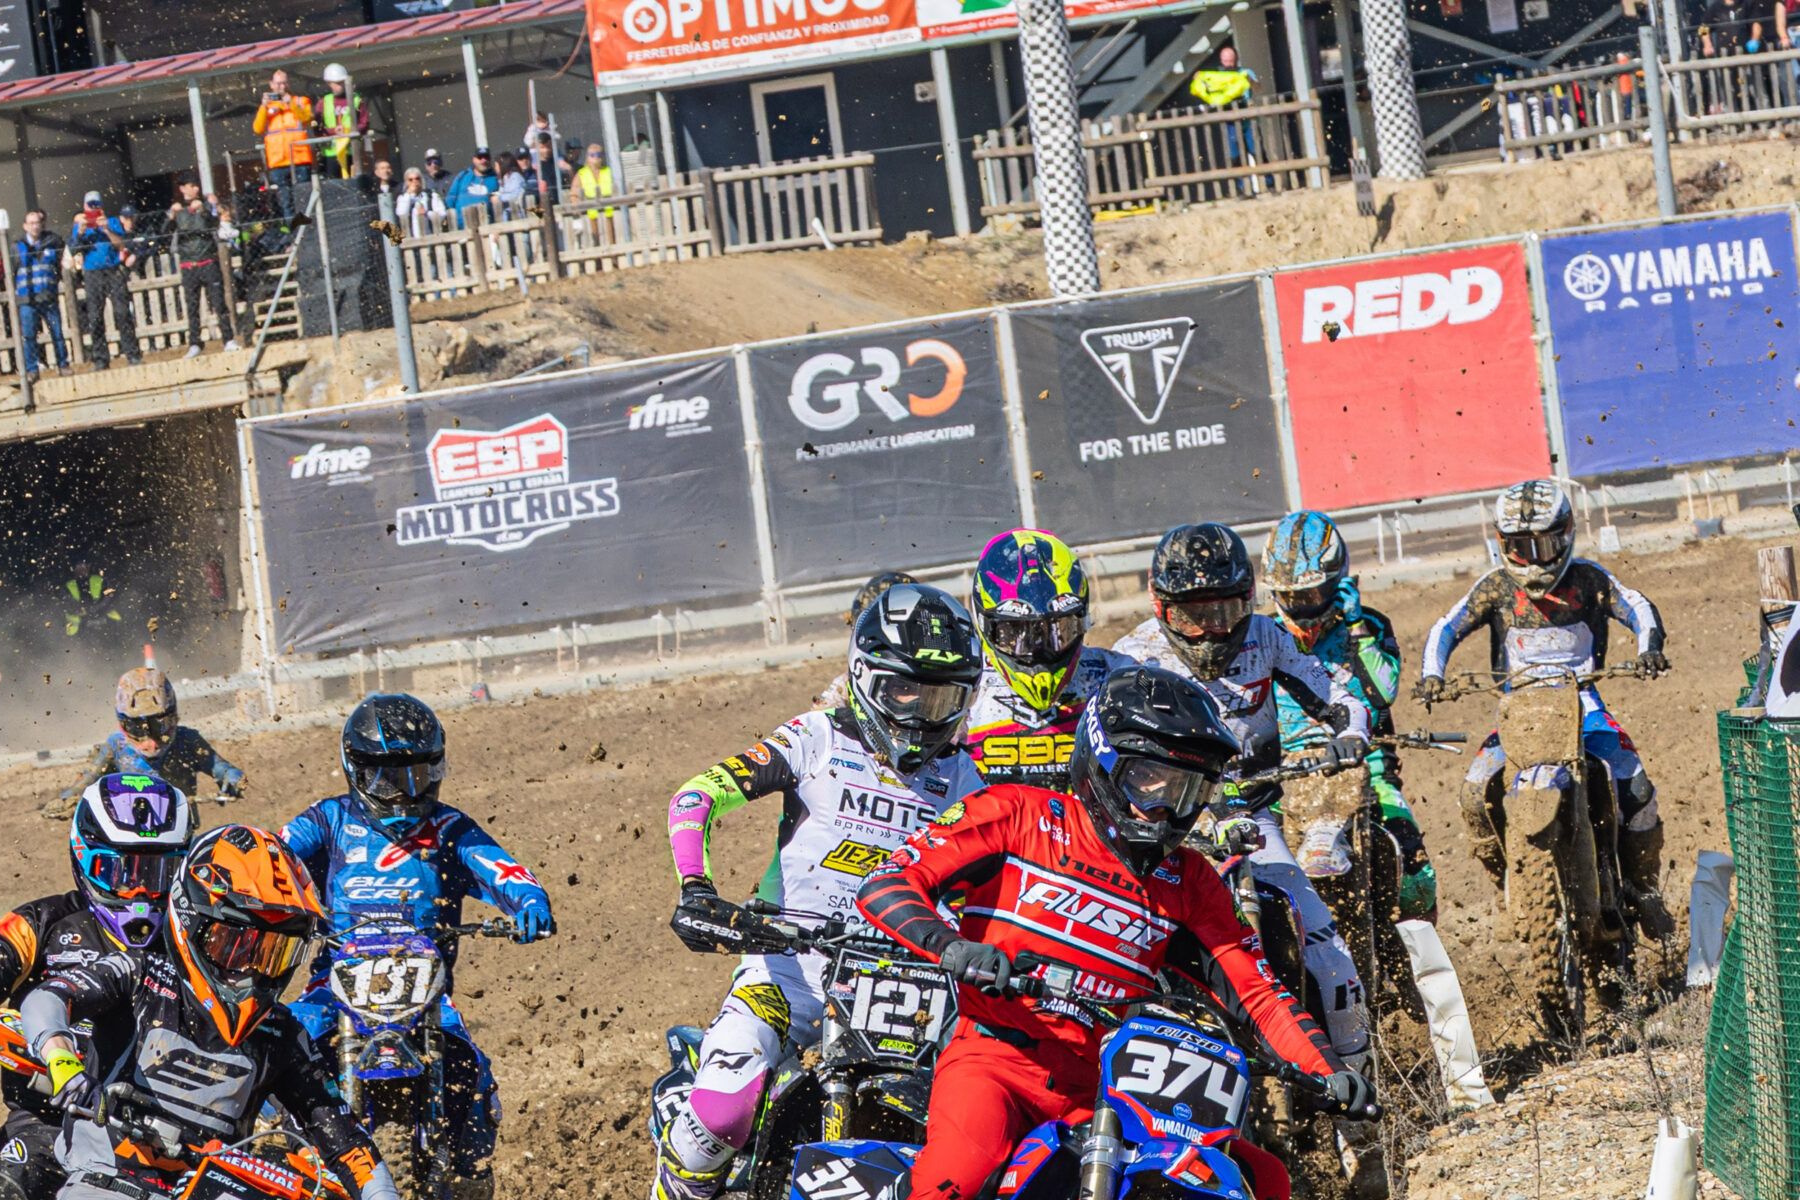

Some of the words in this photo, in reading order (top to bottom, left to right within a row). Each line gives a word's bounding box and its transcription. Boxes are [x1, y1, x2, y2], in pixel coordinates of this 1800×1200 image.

[712, 38, 731, 50] DE
[732, 30, 800, 48] CONFIANZA
[801, 25, 812, 37] Y
[814, 15, 890, 36] PROXIMIDAD
[1610, 237, 1774, 293] YAMAHA
[1302, 265, 1504, 344] REDD
[1585, 281, 1765, 312] RACING
[1102, 326, 1176, 350] TRIUMPH
[628, 394, 711, 431] rfme
[890, 424, 976, 449] LUBRICATION
[1080, 440, 1124, 463] FOR
[1127, 432, 1171, 457] THE
[1176, 423, 1227, 450] RIDE
[290, 443, 373, 480] rfme
[435, 428, 562, 489] ESP
[402, 486, 617, 541] MOTOCROSS
[916, 649, 963, 664] FLY
[990, 766, 1015, 775] MX
[837, 787, 938, 832] MOTS
[834, 818, 875, 835] BORN
[344, 876, 421, 888] BLU
[59, 933, 83, 947] GRO
[678, 915, 744, 941] ACERBIS
[909, 969, 948, 984] GORKA
[850, 976, 948, 1043] 121
[1115, 1039, 1248, 1126] 374
[1151, 1117, 1205, 1146] YAMALUBE
